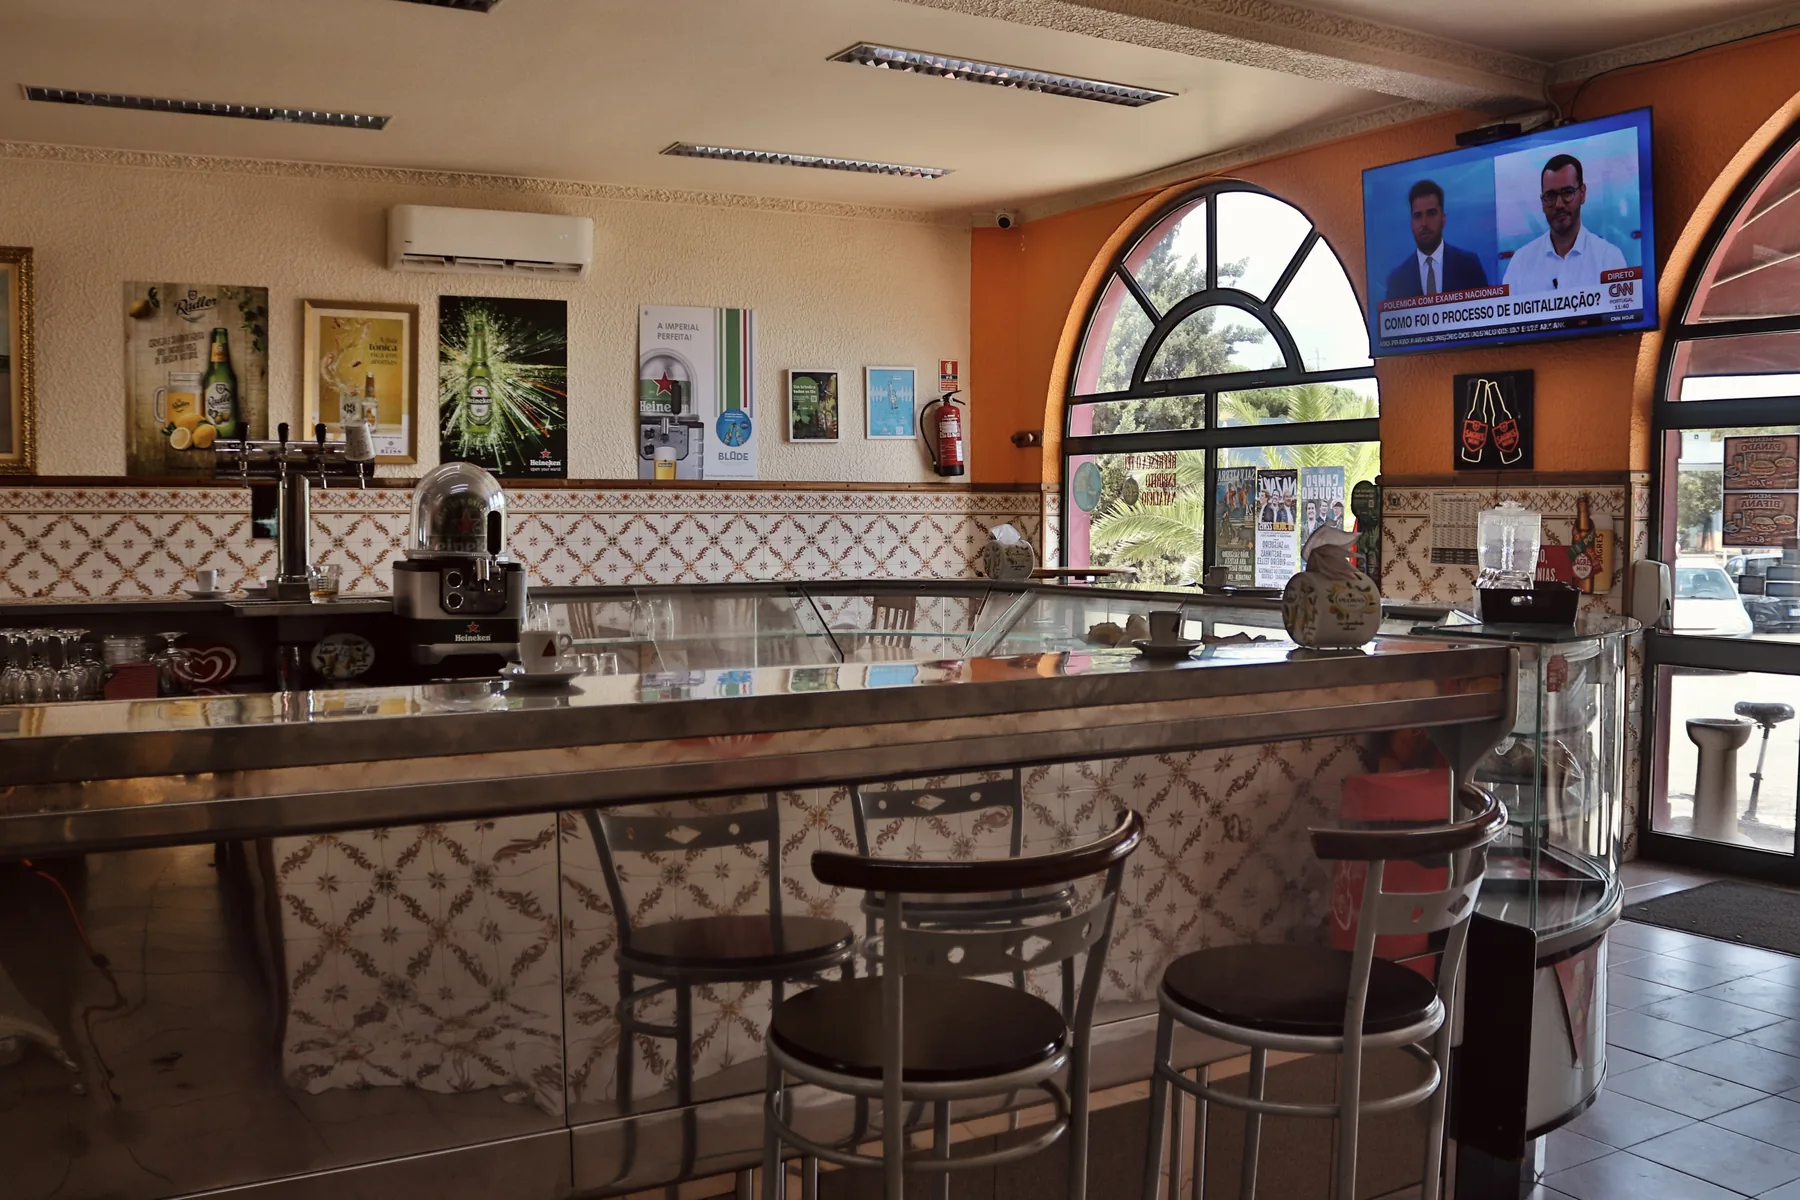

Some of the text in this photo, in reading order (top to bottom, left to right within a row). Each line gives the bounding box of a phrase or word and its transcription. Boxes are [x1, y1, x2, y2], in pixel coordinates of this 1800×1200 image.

[1607, 271, 1634, 280] DIRETO
[1608, 282, 1634, 297] CNN
[1418, 296, 1434, 305] COM
[1435, 292, 1463, 303] EXAMES
[1464, 287, 1504, 300] NACIONAIS
[174, 296, 217, 315] Radler
[1384, 291, 1601, 330] COMO FOI O PROCESSO DE DIGITALIZAÇÃO?
[665, 323, 700, 331] IMPERIAL
[657, 332, 692, 341] PERFEITA!
[640, 400, 689, 412] Heineen
[1465, 429, 1485, 441] SAGRES
[1497, 429, 1517, 444] SAGRES
[718, 451, 749, 461] BLADE
[530, 459, 561, 467] Heineken
[455, 634, 491, 642] Heineken
